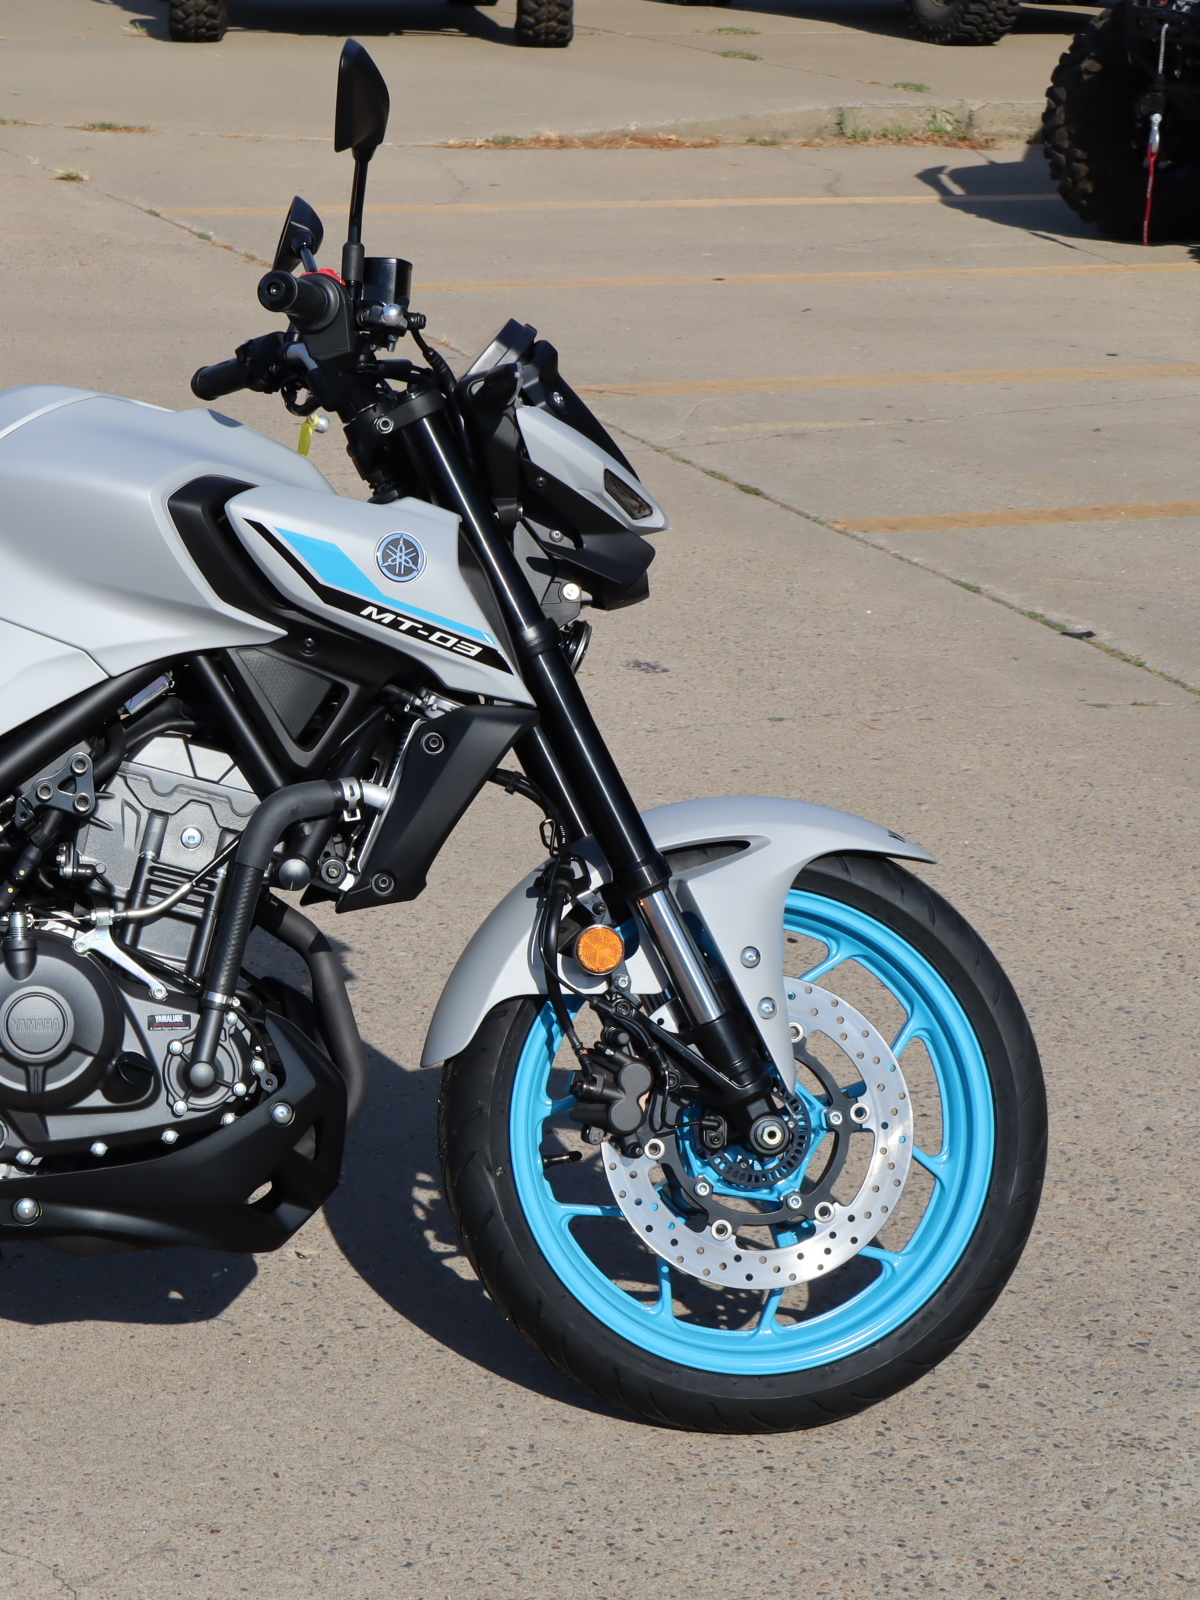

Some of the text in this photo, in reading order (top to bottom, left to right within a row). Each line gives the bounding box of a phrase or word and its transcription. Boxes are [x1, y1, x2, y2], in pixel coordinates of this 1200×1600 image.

[359, 605, 484, 657] MT-03
[11, 1018, 61, 1031] YAMAHA
[154, 1014, 184, 1023] YAMALUBE
